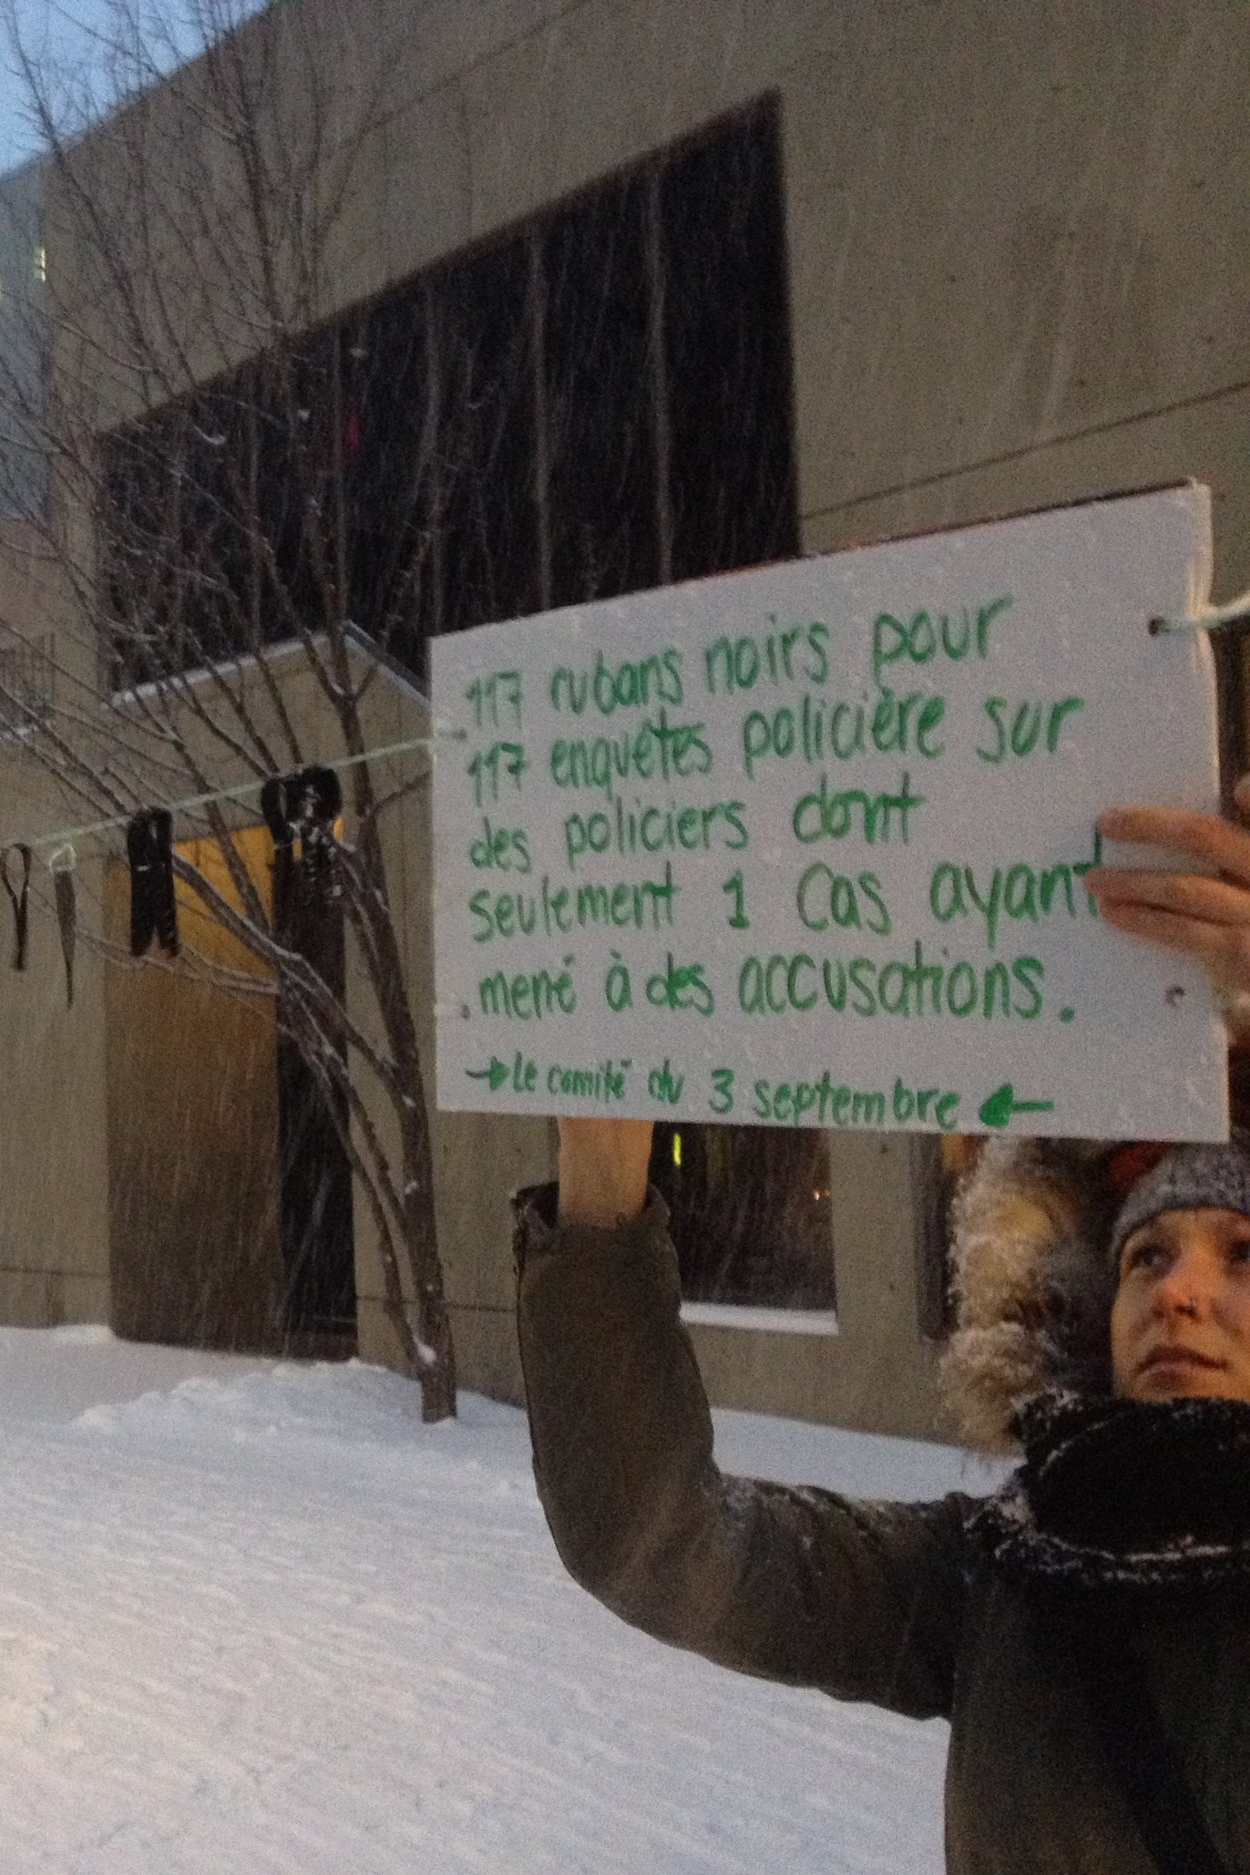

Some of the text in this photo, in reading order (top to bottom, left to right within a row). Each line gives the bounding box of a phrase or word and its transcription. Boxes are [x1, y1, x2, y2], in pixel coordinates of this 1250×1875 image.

[549, 648, 685, 716] rubans
[704, 613, 830, 695] noirs
[871, 593, 1014, 686] pour
[976, 695, 1085, 763] sur
[469, 771, 926, 874] des policiers dont
[469, 860, 681, 943] seulement
[722, 868, 751, 930] 1
[605, 950, 633, 1013] à
[646, 952, 715, 1017] des
[737, 938, 1076, 1021] accusations.
[648, 1056, 684, 1104] du
[708, 1068, 735, 1114] 3
[753, 1070, 962, 1131] septembre
